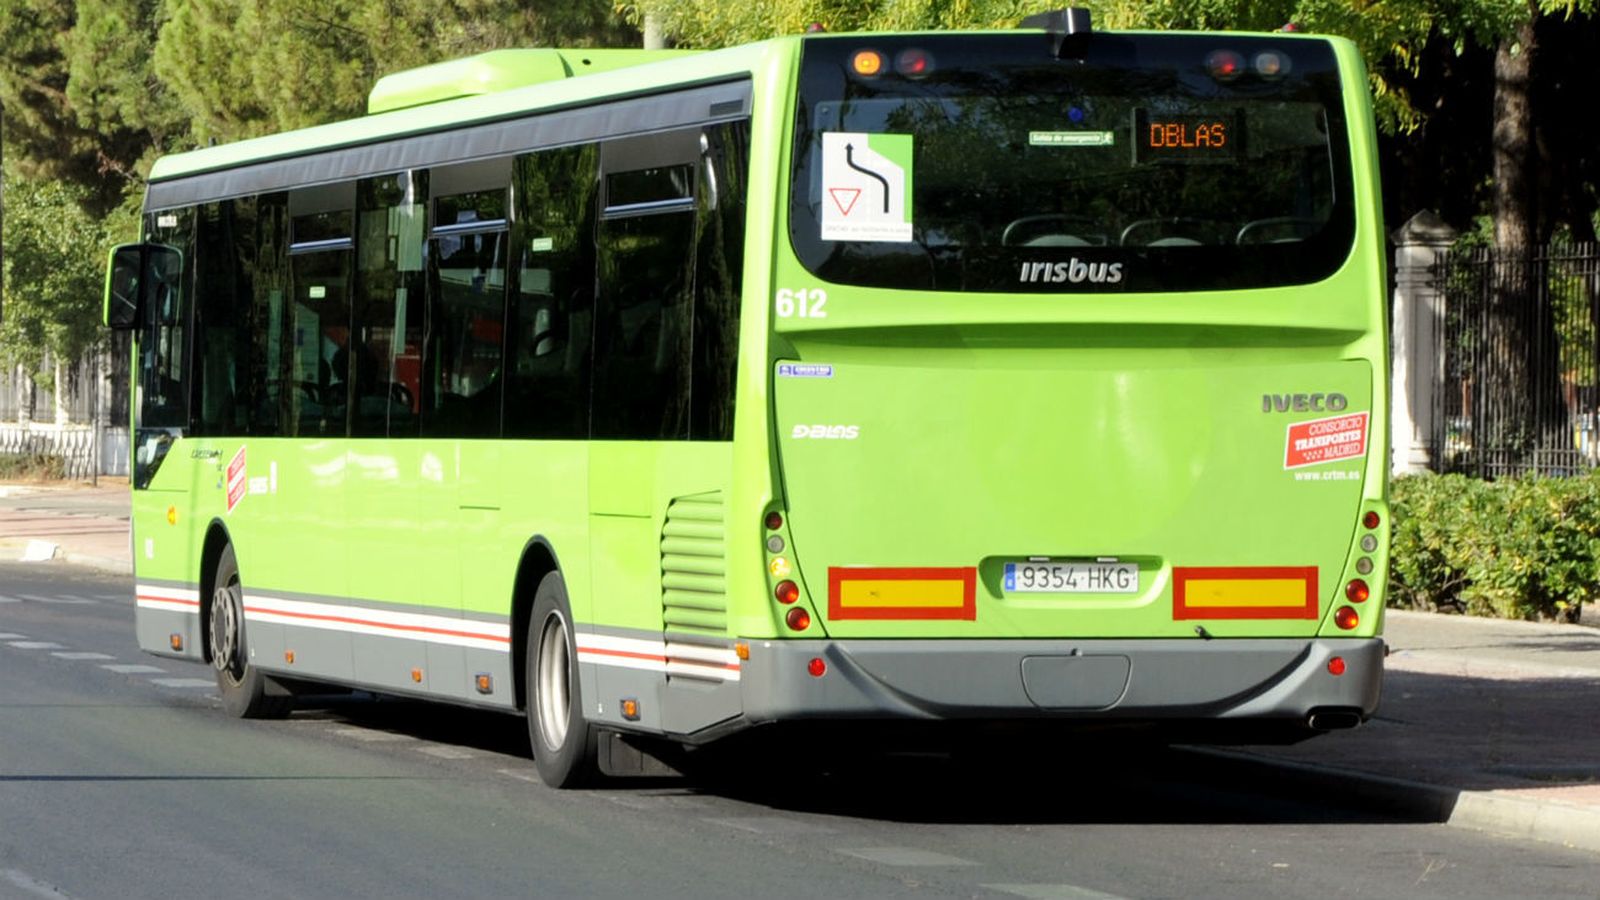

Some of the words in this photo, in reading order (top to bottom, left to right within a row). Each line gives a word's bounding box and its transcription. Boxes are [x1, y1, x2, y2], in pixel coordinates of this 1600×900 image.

[1150, 123, 1226, 148] DBLAS
[775, 288, 828, 319] 612
[1262, 392, 1349, 413] IVECO
[1309, 415, 1362, 436] CONSORCIO
[1295, 430, 1361, 452] TRANSPORTES
[1323, 442, 1361, 459] MADRID
[1294, 470, 1361, 481] www.crtm.es
[1022, 566, 1078, 589] 9354
[1087, 567, 1131, 590] HKG
